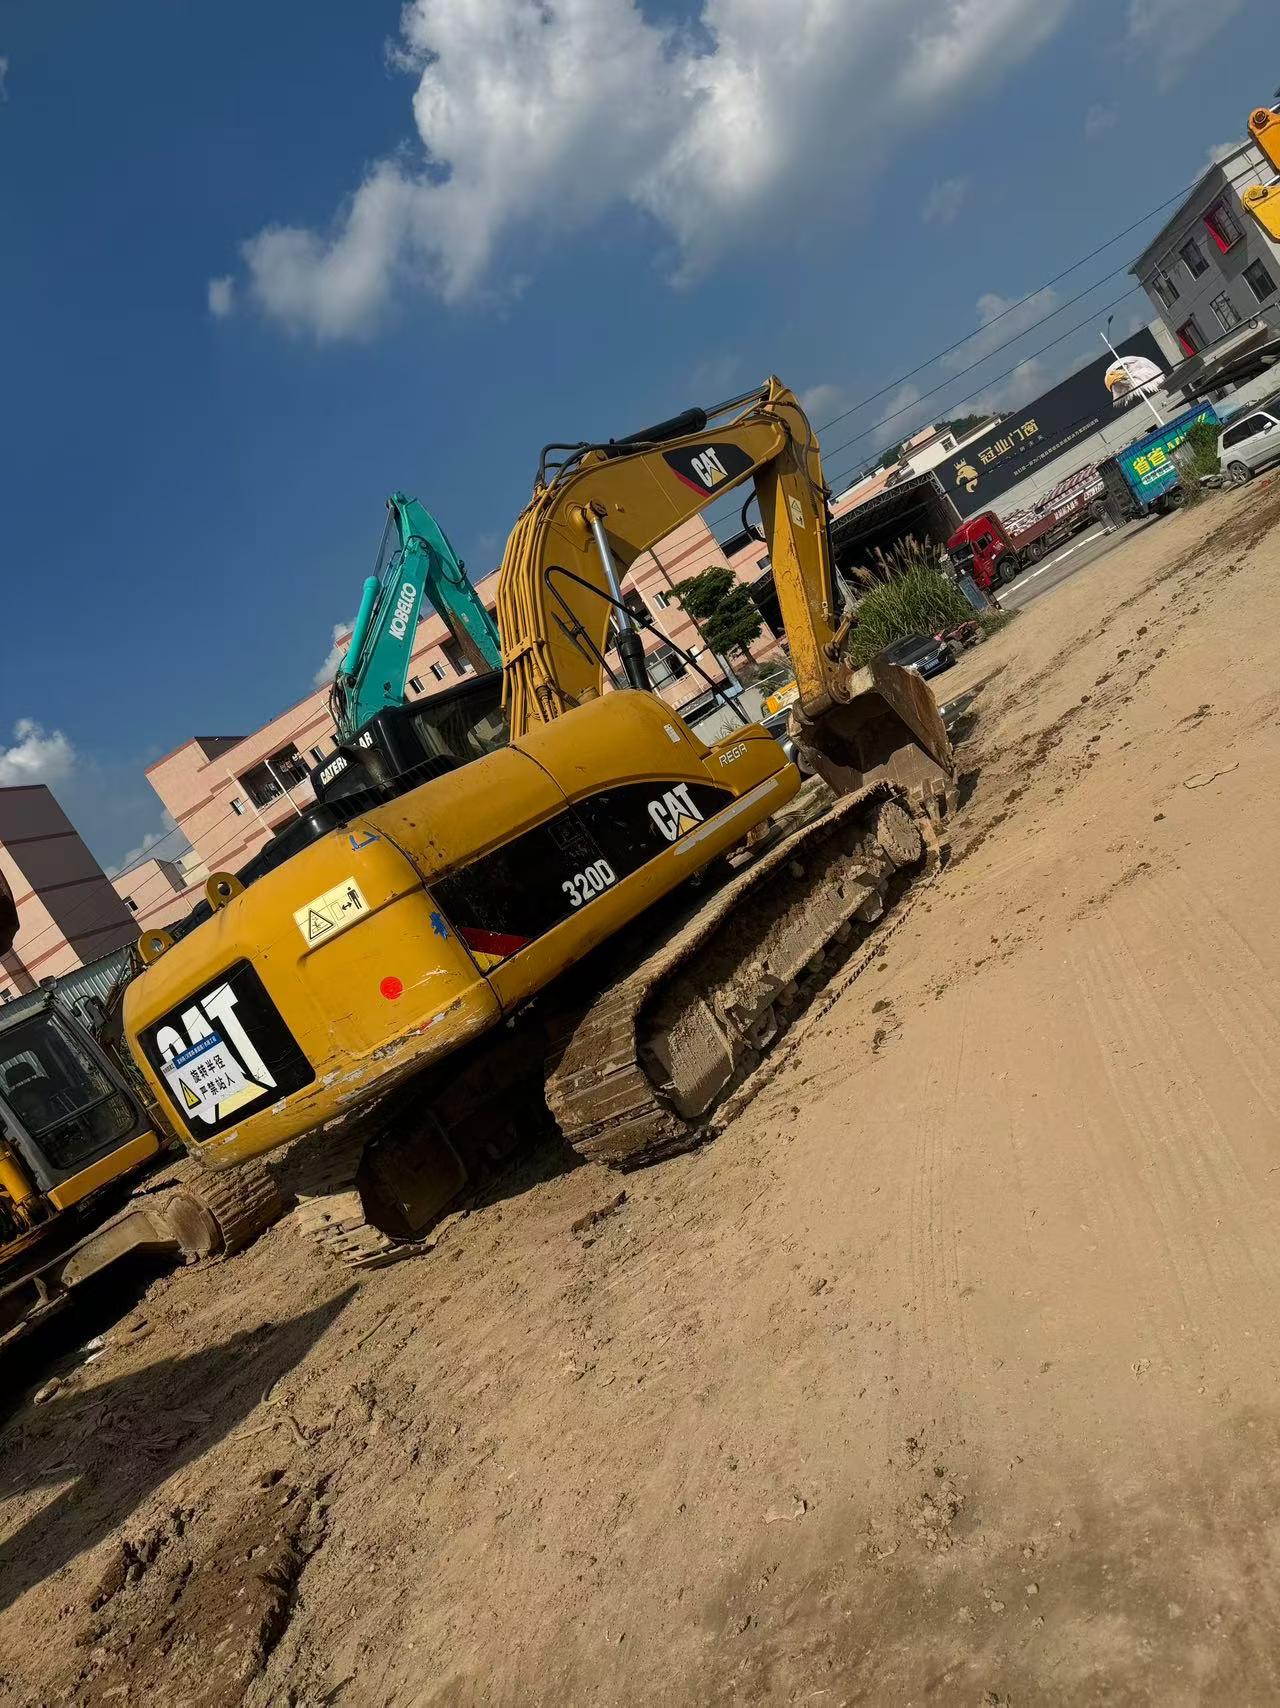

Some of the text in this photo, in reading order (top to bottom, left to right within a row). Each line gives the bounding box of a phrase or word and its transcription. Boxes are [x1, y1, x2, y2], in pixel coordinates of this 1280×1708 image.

[978, 419, 1038, 465] 冠业门窗
[691, 447, 728, 487] CAT
[389, 583, 416, 640] KOBELCO
[320, 731, 373, 785] CATERAR
[719, 743, 747, 767] REGA
[647, 782, 704, 841] CAT
[561, 859, 616, 907] 320D
[189, 1054, 226, 1083] 旋转半径
[199, 1071, 236, 1100] 严禁站人
